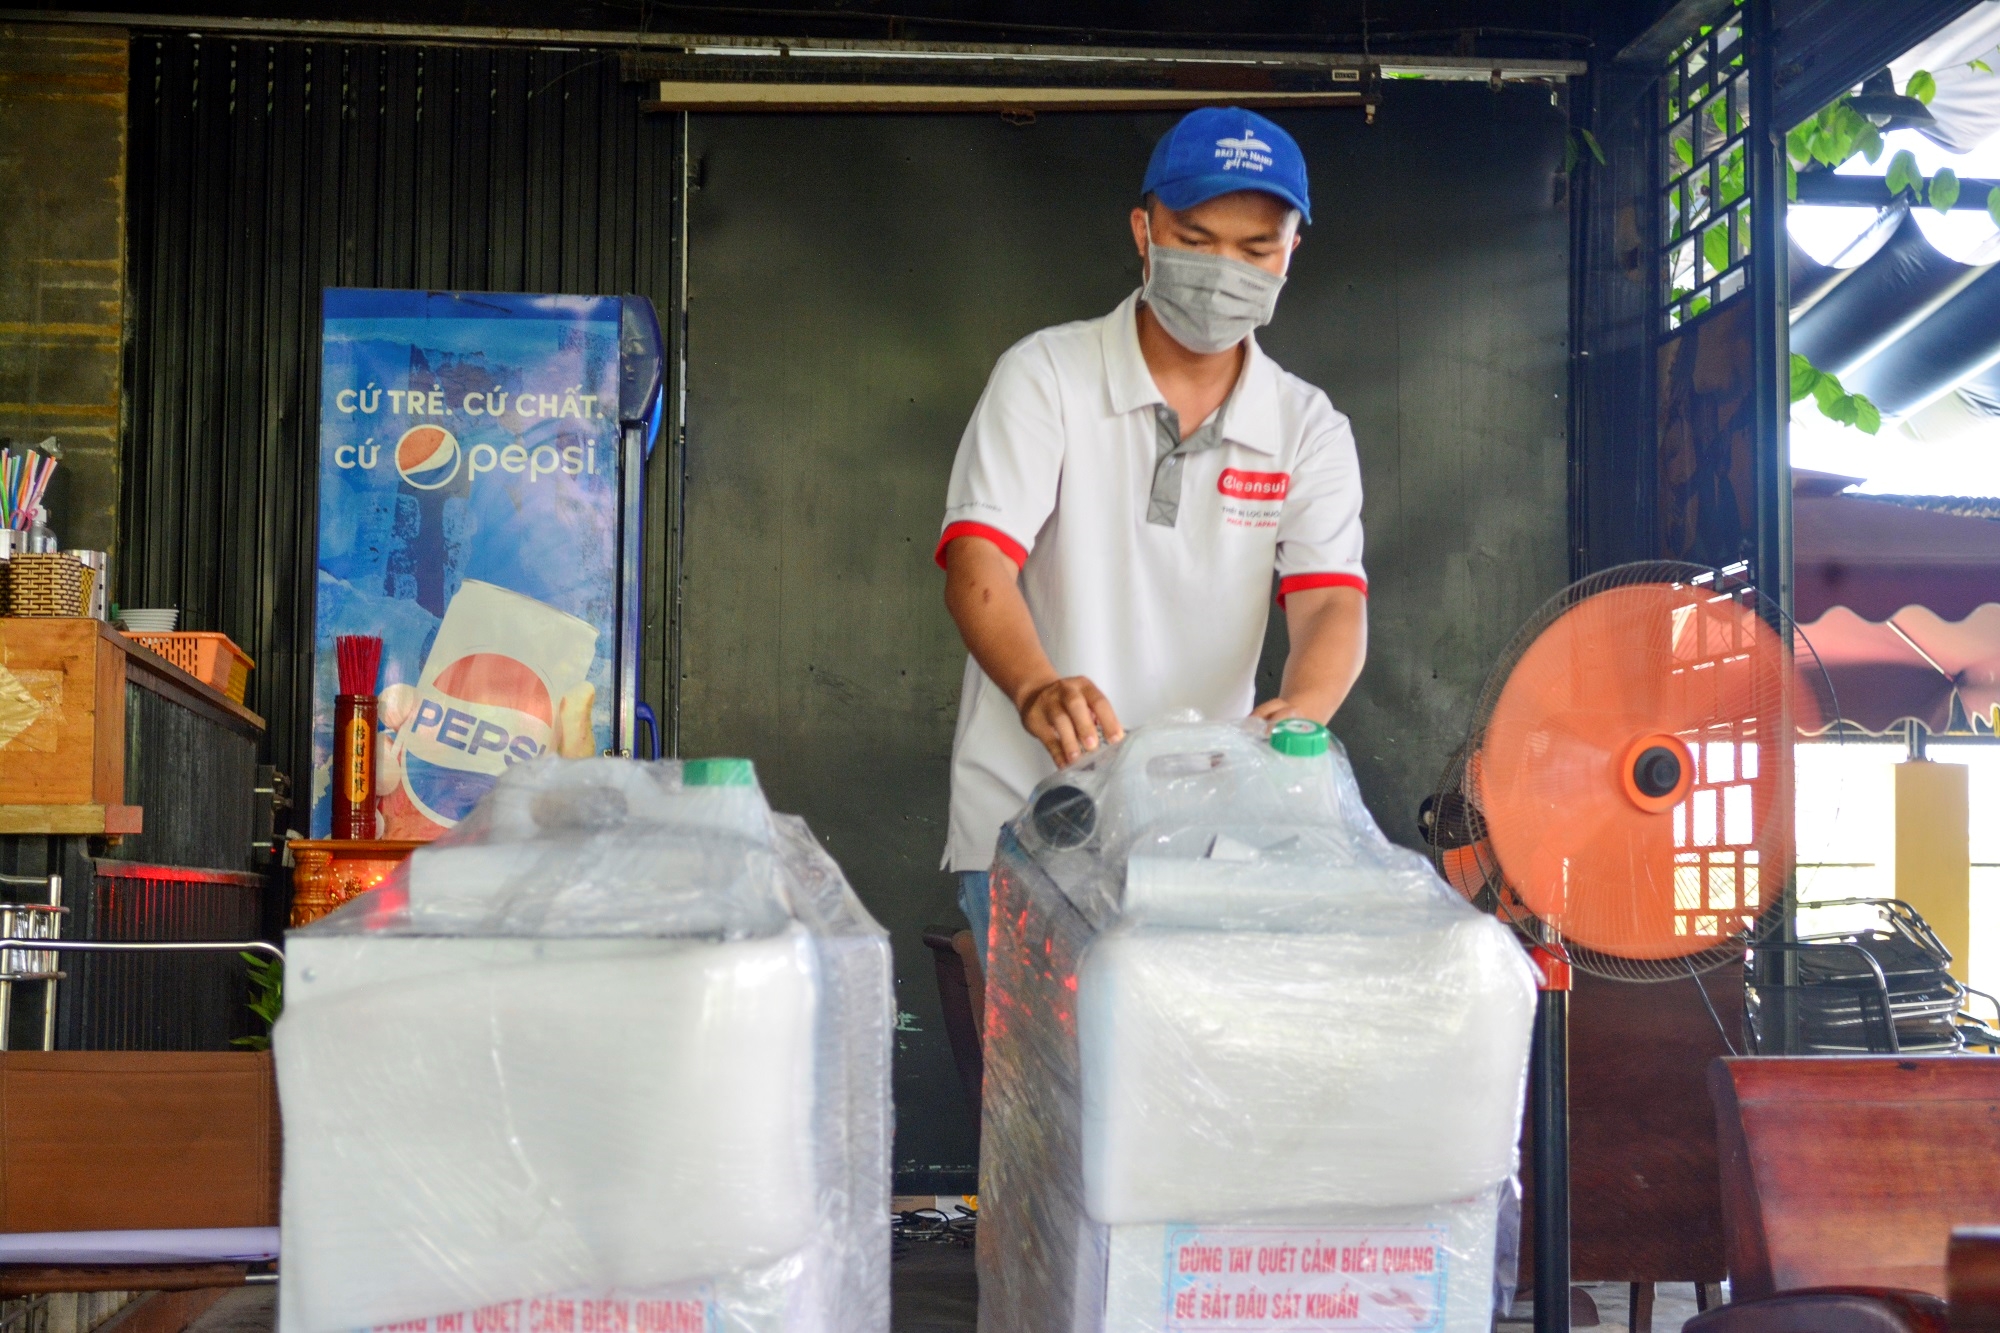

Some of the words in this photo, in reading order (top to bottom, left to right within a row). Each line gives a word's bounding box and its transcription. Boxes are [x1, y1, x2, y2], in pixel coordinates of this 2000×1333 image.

[336, 382, 382, 415] CỨ
[387, 383, 453, 416] TRẺ.
[463, 385, 509, 417] CỨ
[515, 383, 604, 419] CHẤT.
[334, 437, 381, 470] CỨ
[468, 438, 596, 483] pepsi
[1222, 474, 1287, 494] Cleansui
[1229, 1246, 1253, 1273] TAY
[1257, 1241, 1298, 1276] QUÉT
[1301, 1238, 1337, 1273] CẢM
[1341, 1237, 1378, 1273] BIẾN
[1382, 1246, 1434, 1275] QUANG
[635, 1300, 704, 1333] QUANG
[1271, 1288, 1302, 1320] SÁT
